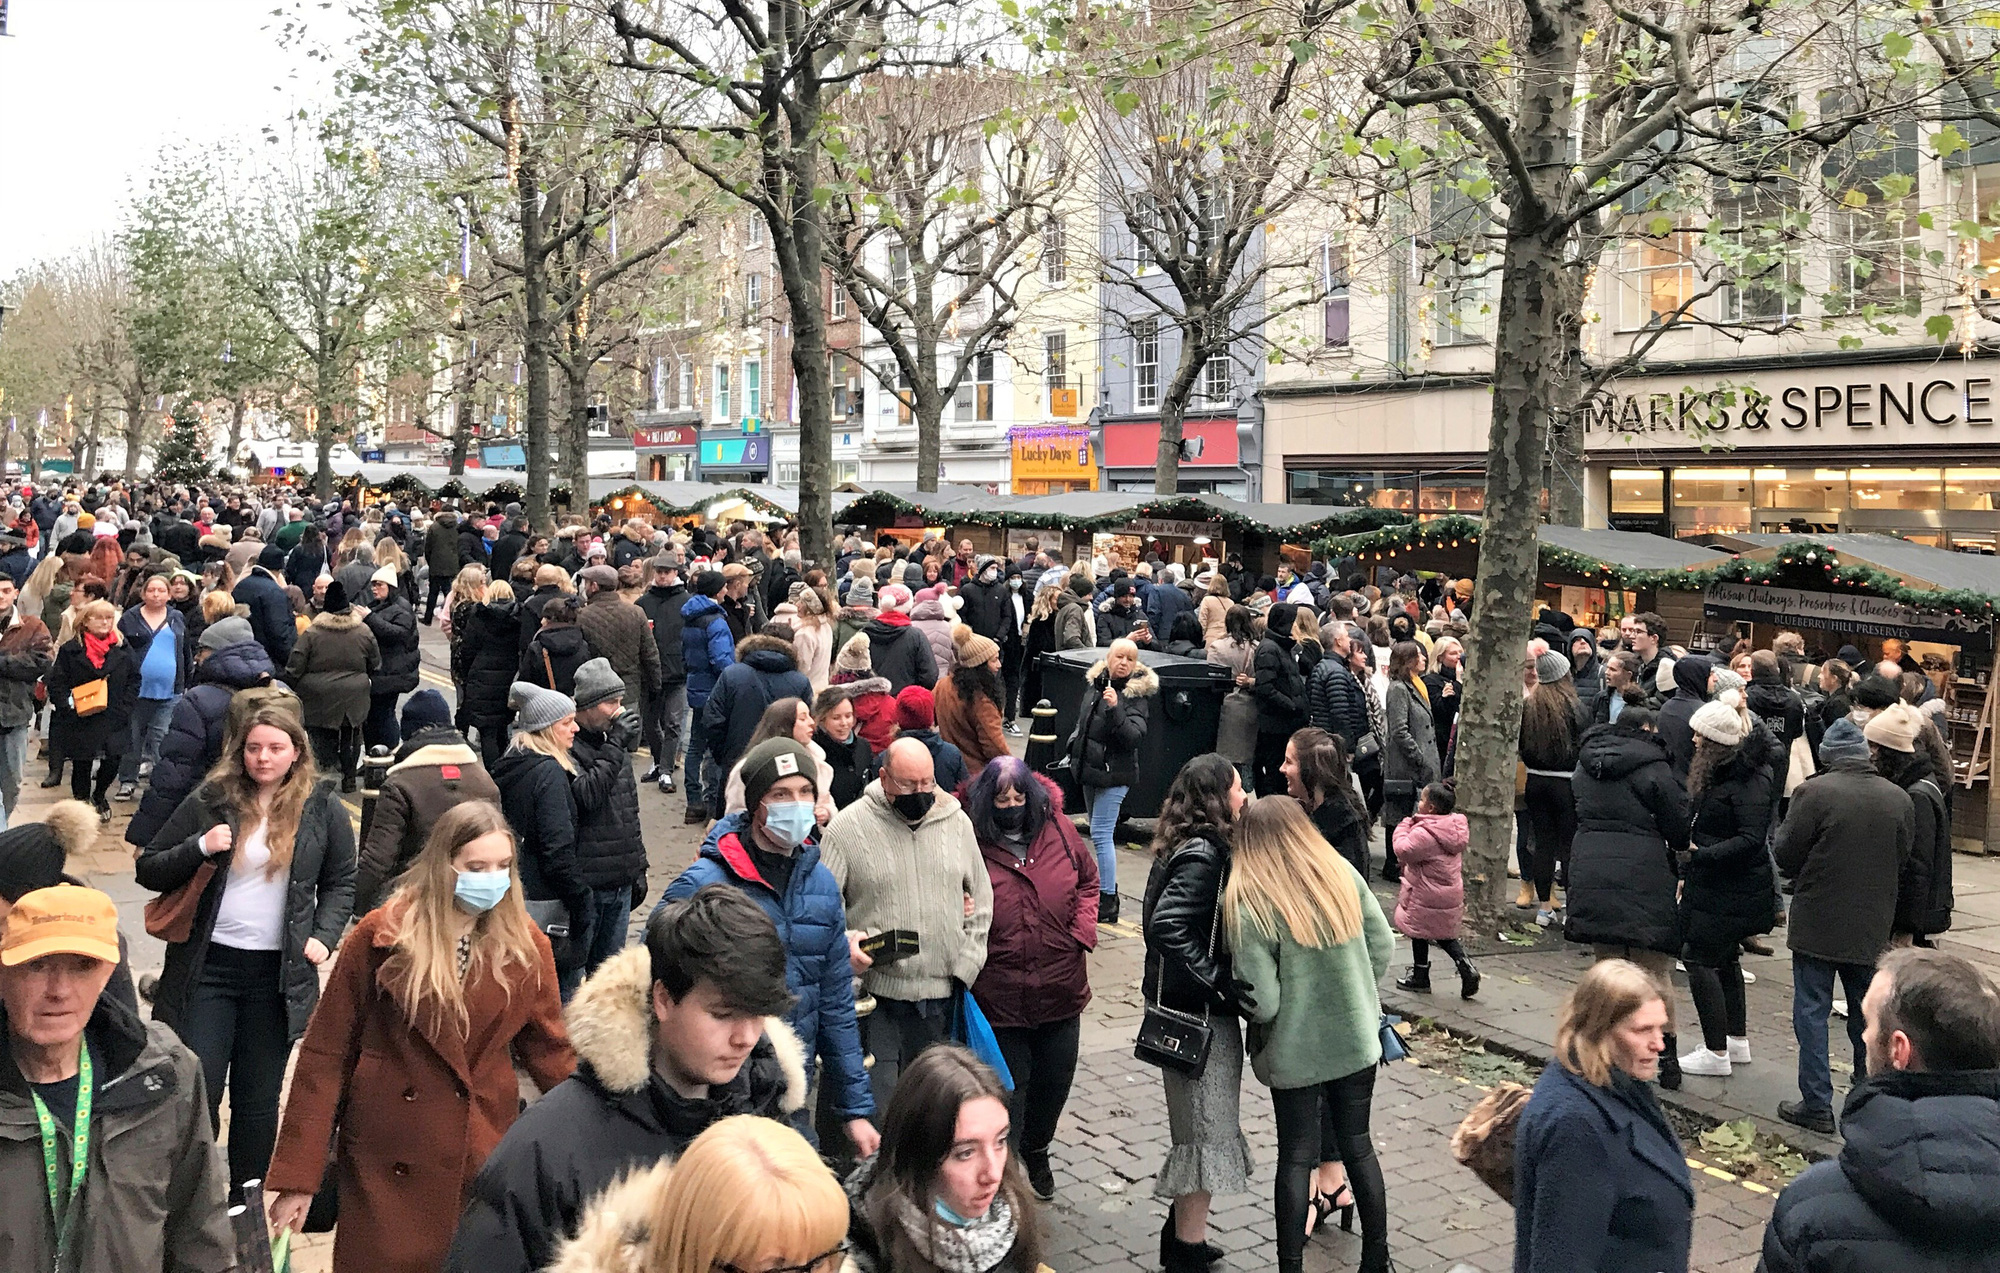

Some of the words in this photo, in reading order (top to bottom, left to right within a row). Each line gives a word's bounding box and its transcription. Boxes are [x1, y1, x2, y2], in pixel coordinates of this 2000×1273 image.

[1583, 390, 1731, 433] MARKS
[1742, 389, 1771, 430] &
[1781, 378, 1993, 429] SPENCE
[1021, 445, 1048, 464] Lucky
[1050, 446, 1072, 464] Days
[1144, 521, 1164, 533] York
[1174, 522, 1189, 534] Old
[1707, 583, 1745, 602] Artisan
[1799, 591, 1847, 612] Preserves
[1850, 597, 1857, 616] &
[1859, 599, 1900, 618] Cheeses
[1774, 614, 1829, 630] BLUEBERRY
[1831, 620, 1855, 633] HILL
[1856, 623, 1911, 638] PRESERVES
